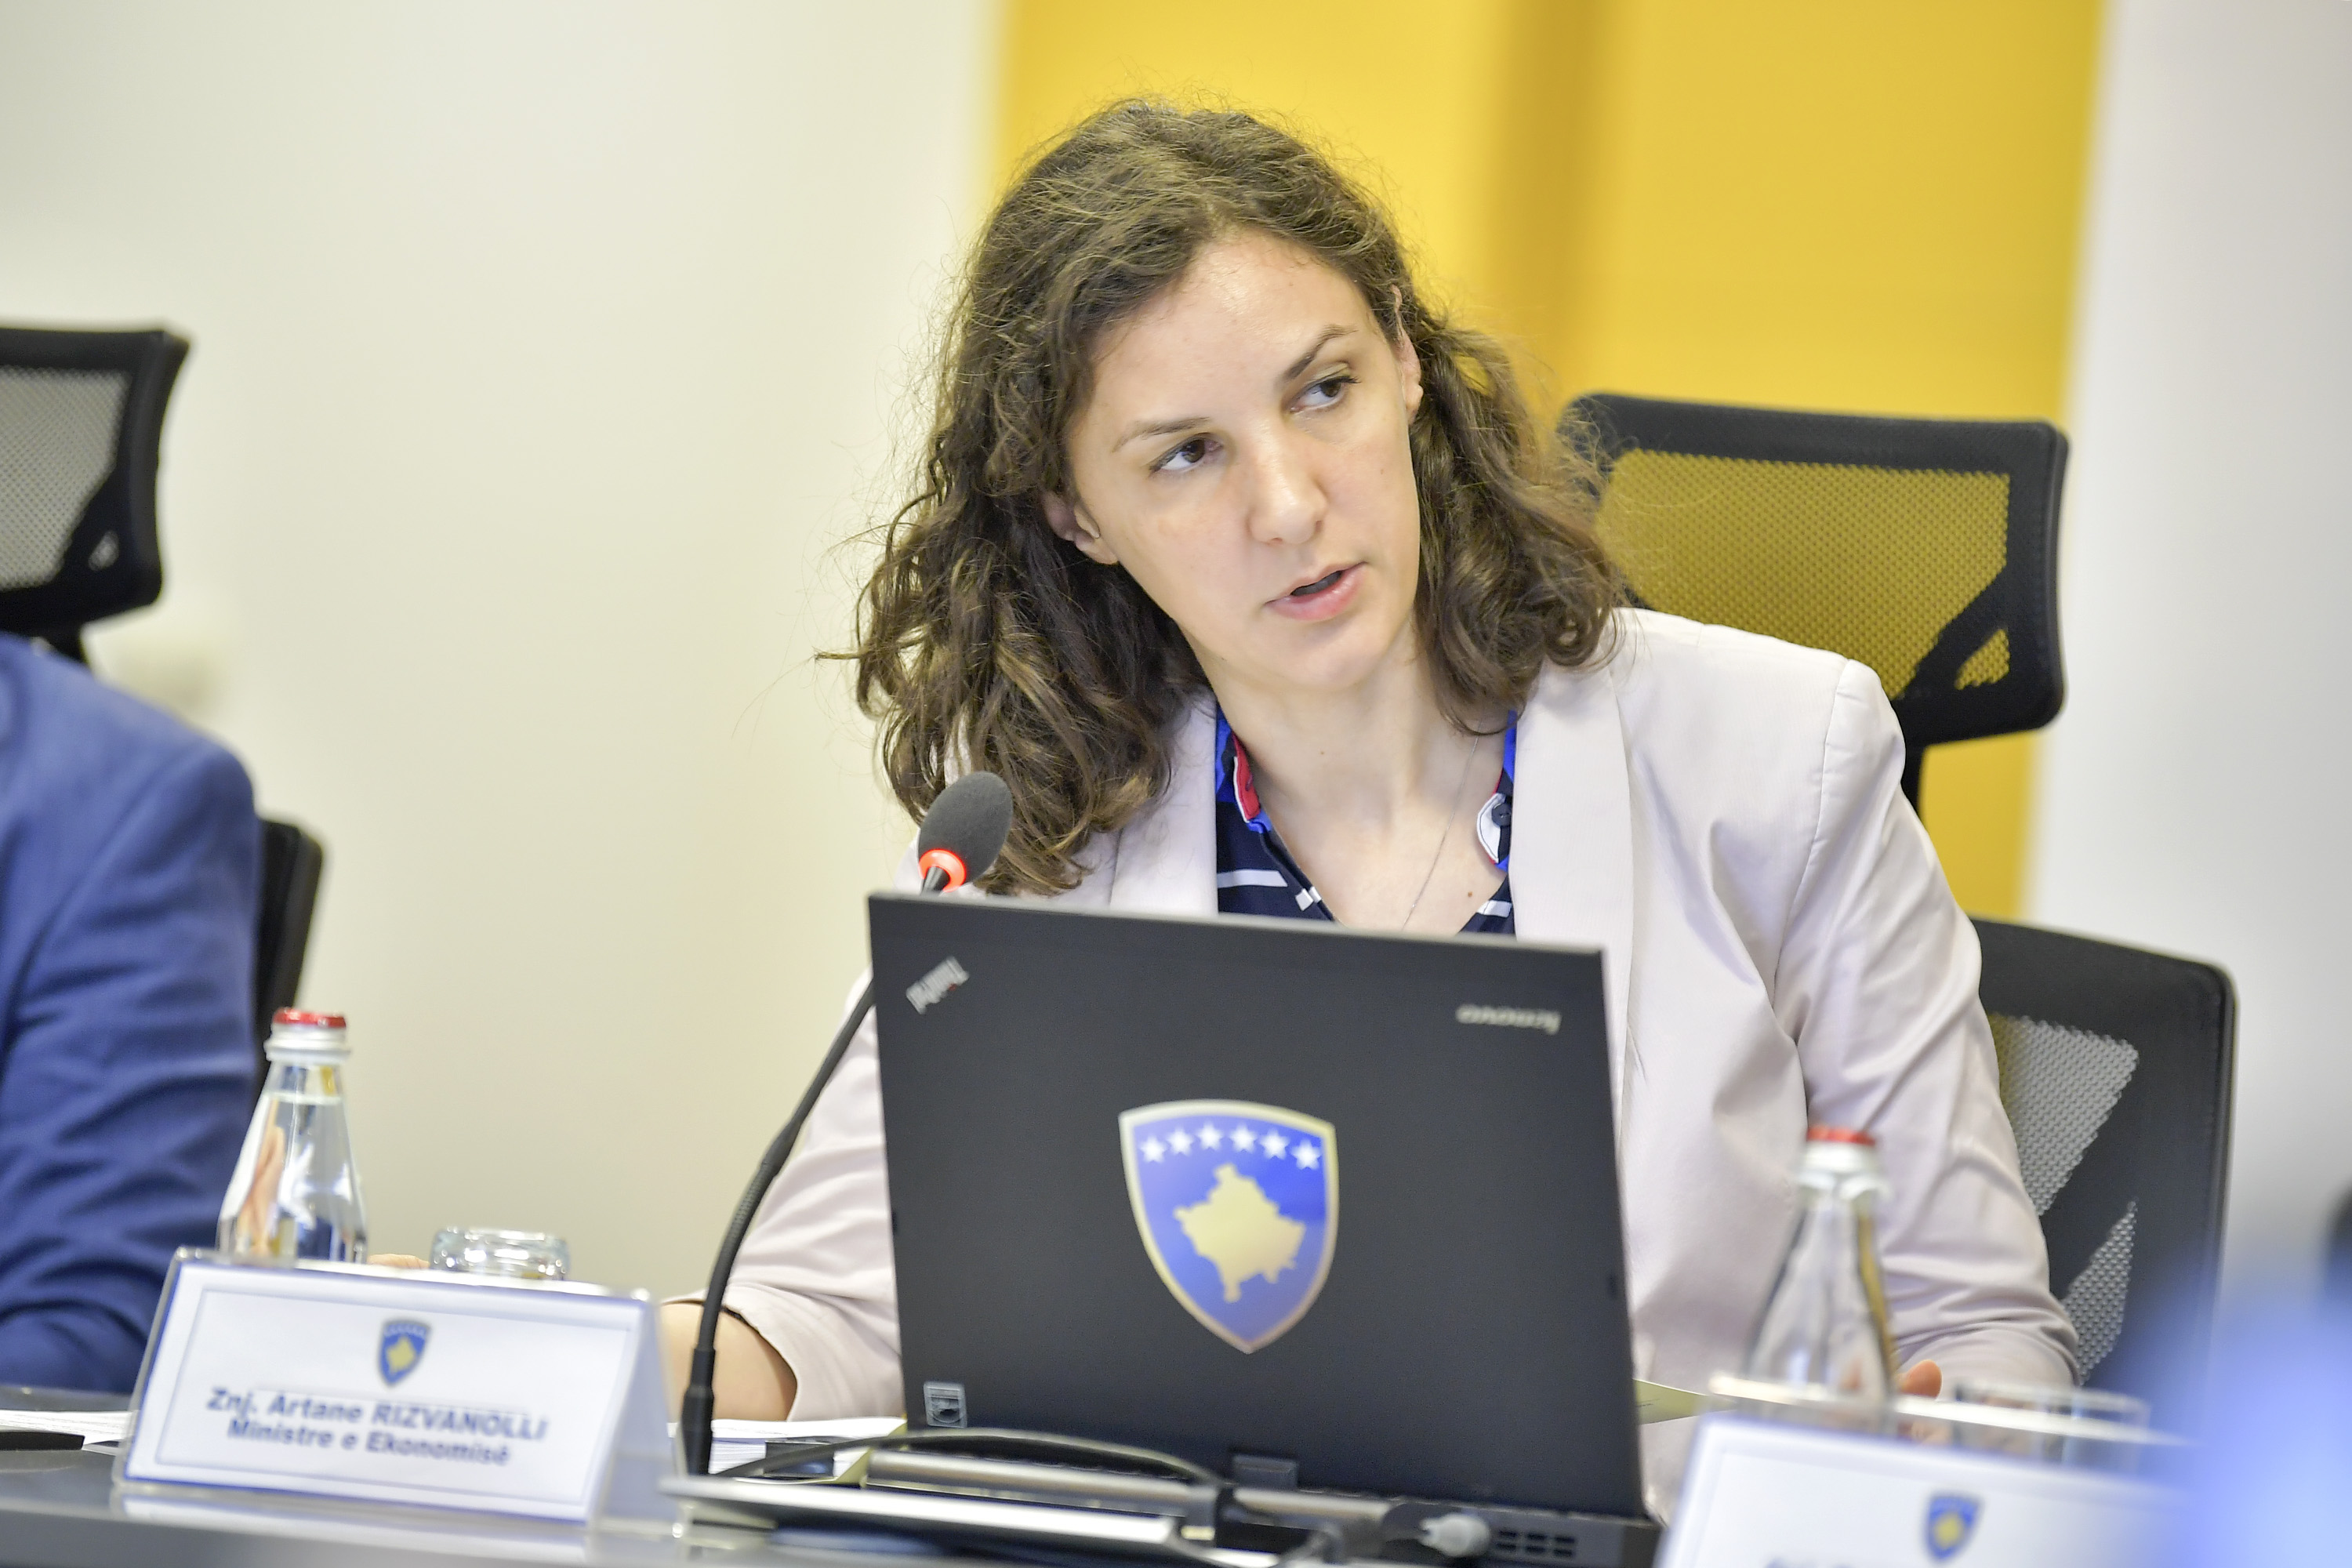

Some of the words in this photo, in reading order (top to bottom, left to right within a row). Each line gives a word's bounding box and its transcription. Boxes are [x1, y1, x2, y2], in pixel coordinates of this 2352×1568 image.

[267, 1392, 363, 1423] Artane
[371, 1403, 549, 1441] RIZVANOLLI
[227, 1419, 333, 1449] Ministre
[341, 1432, 358, 1450] e
[366, 1431, 511, 1466] Ekonomisë
